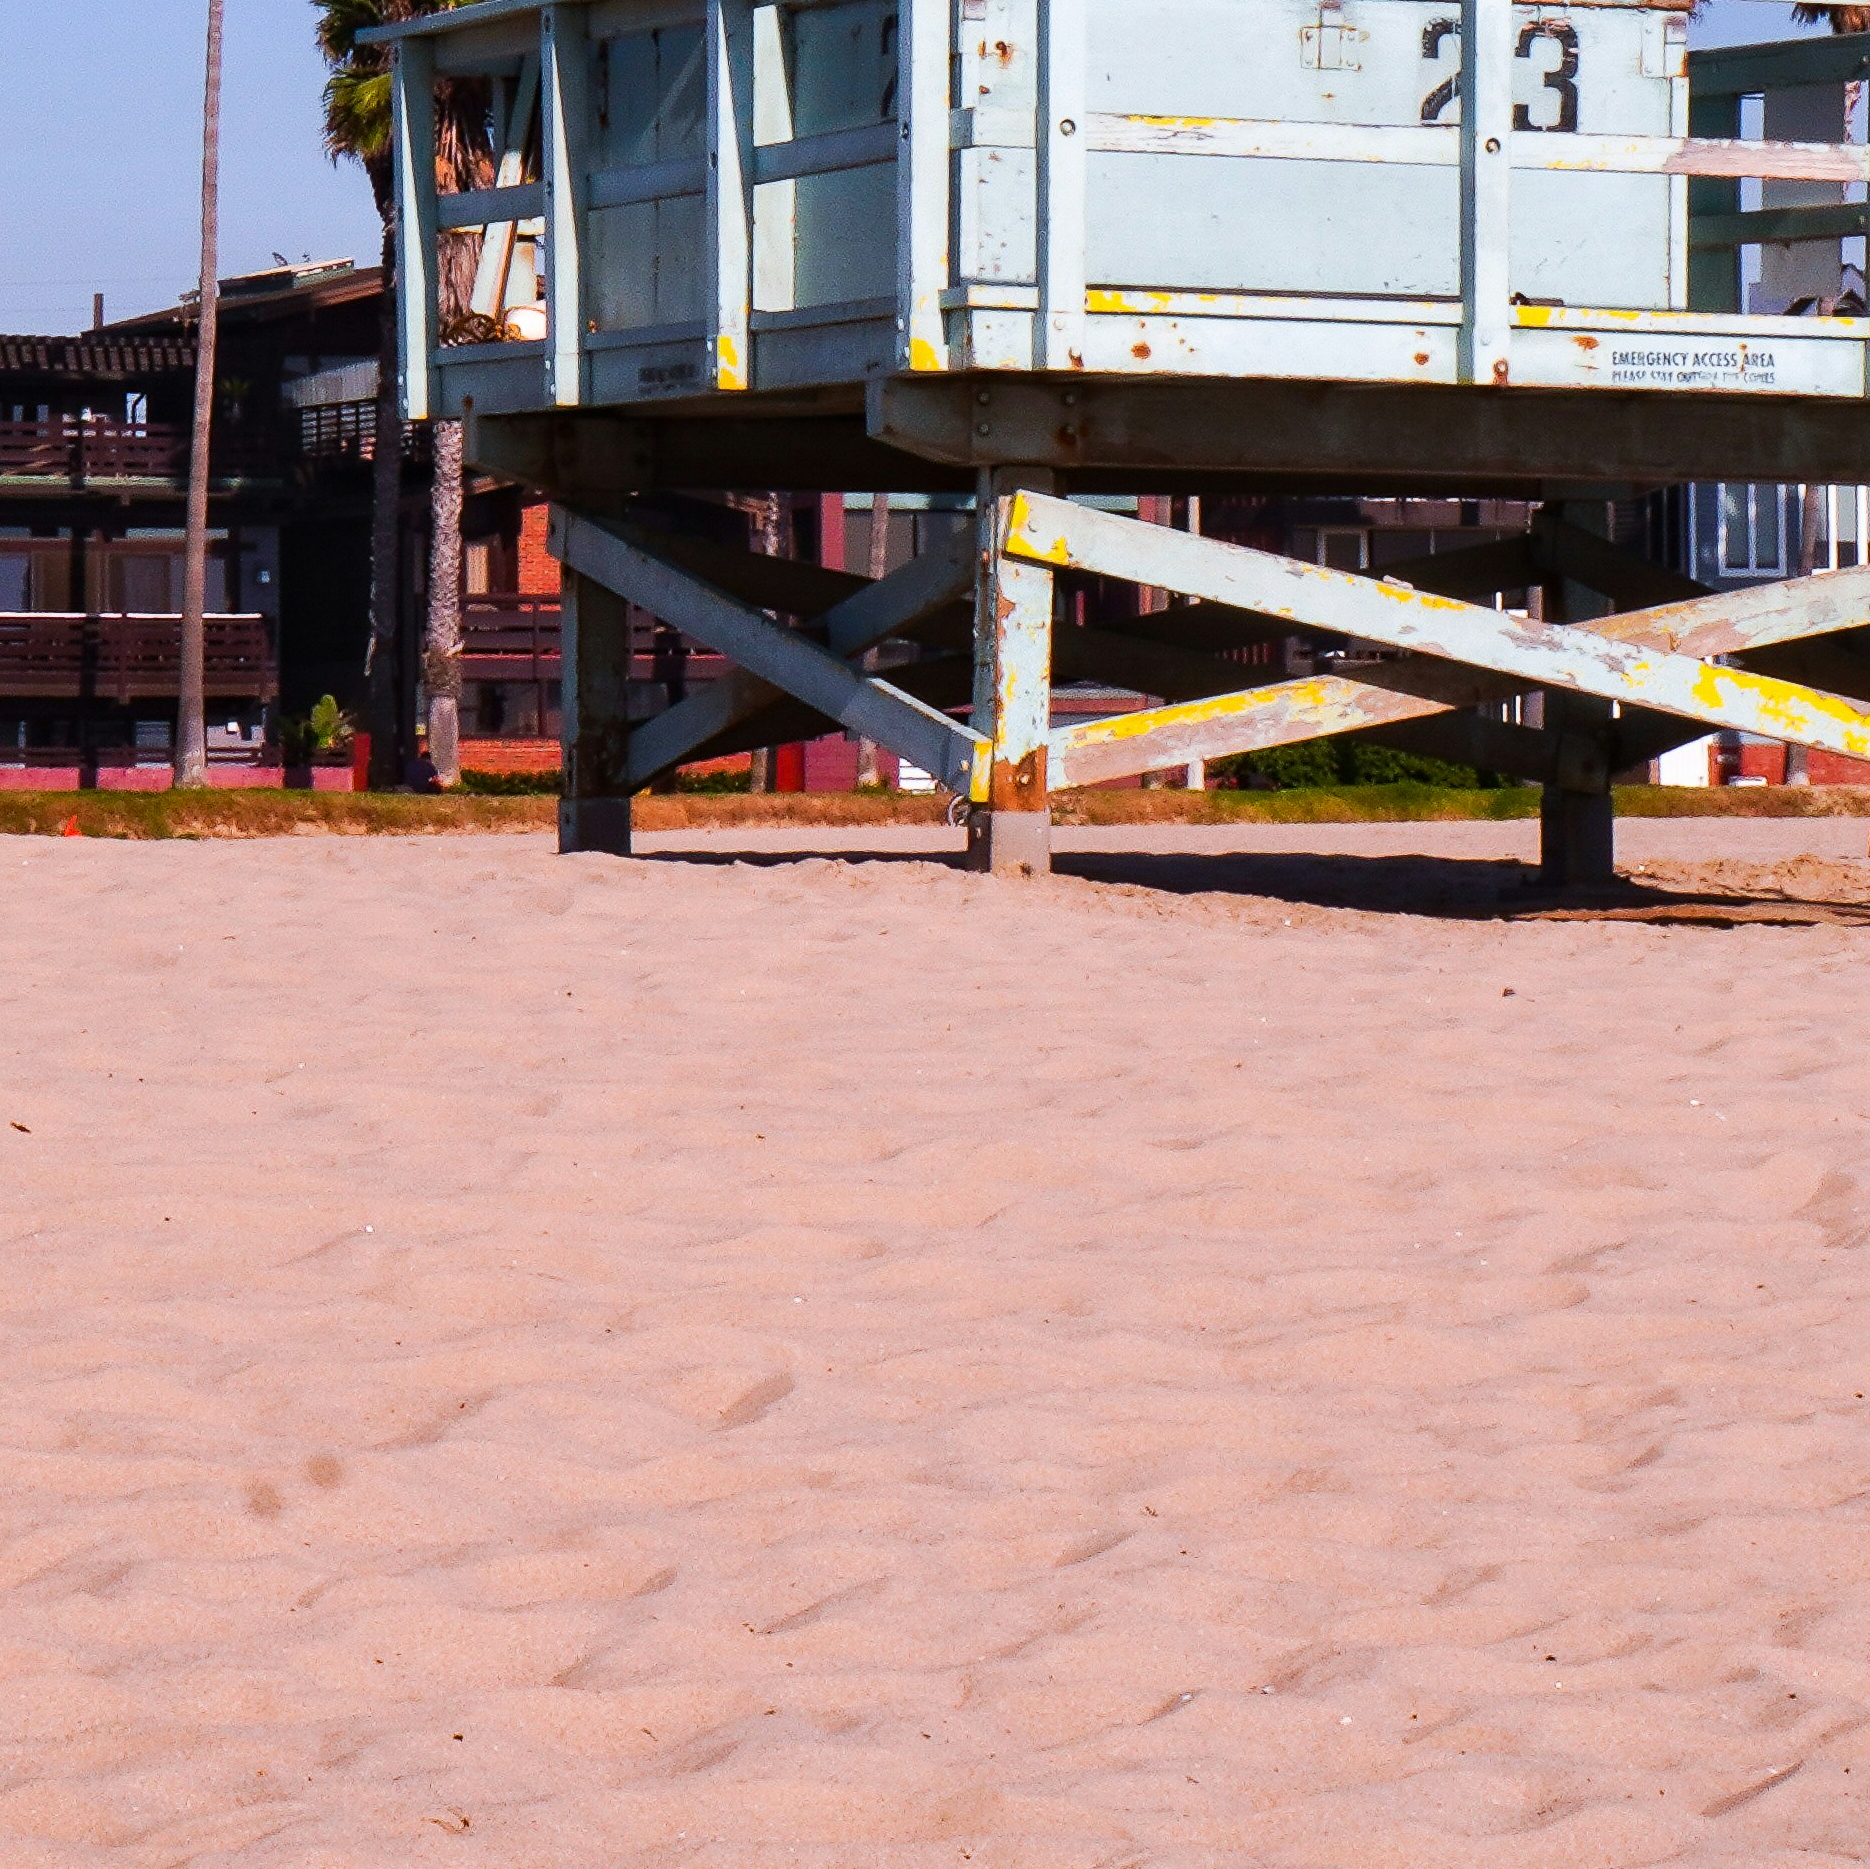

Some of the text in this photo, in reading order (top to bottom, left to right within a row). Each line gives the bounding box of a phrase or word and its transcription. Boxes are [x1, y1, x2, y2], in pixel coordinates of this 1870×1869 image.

[1612, 351, 1775, 367] EMERGENCY ACCESS AREA
